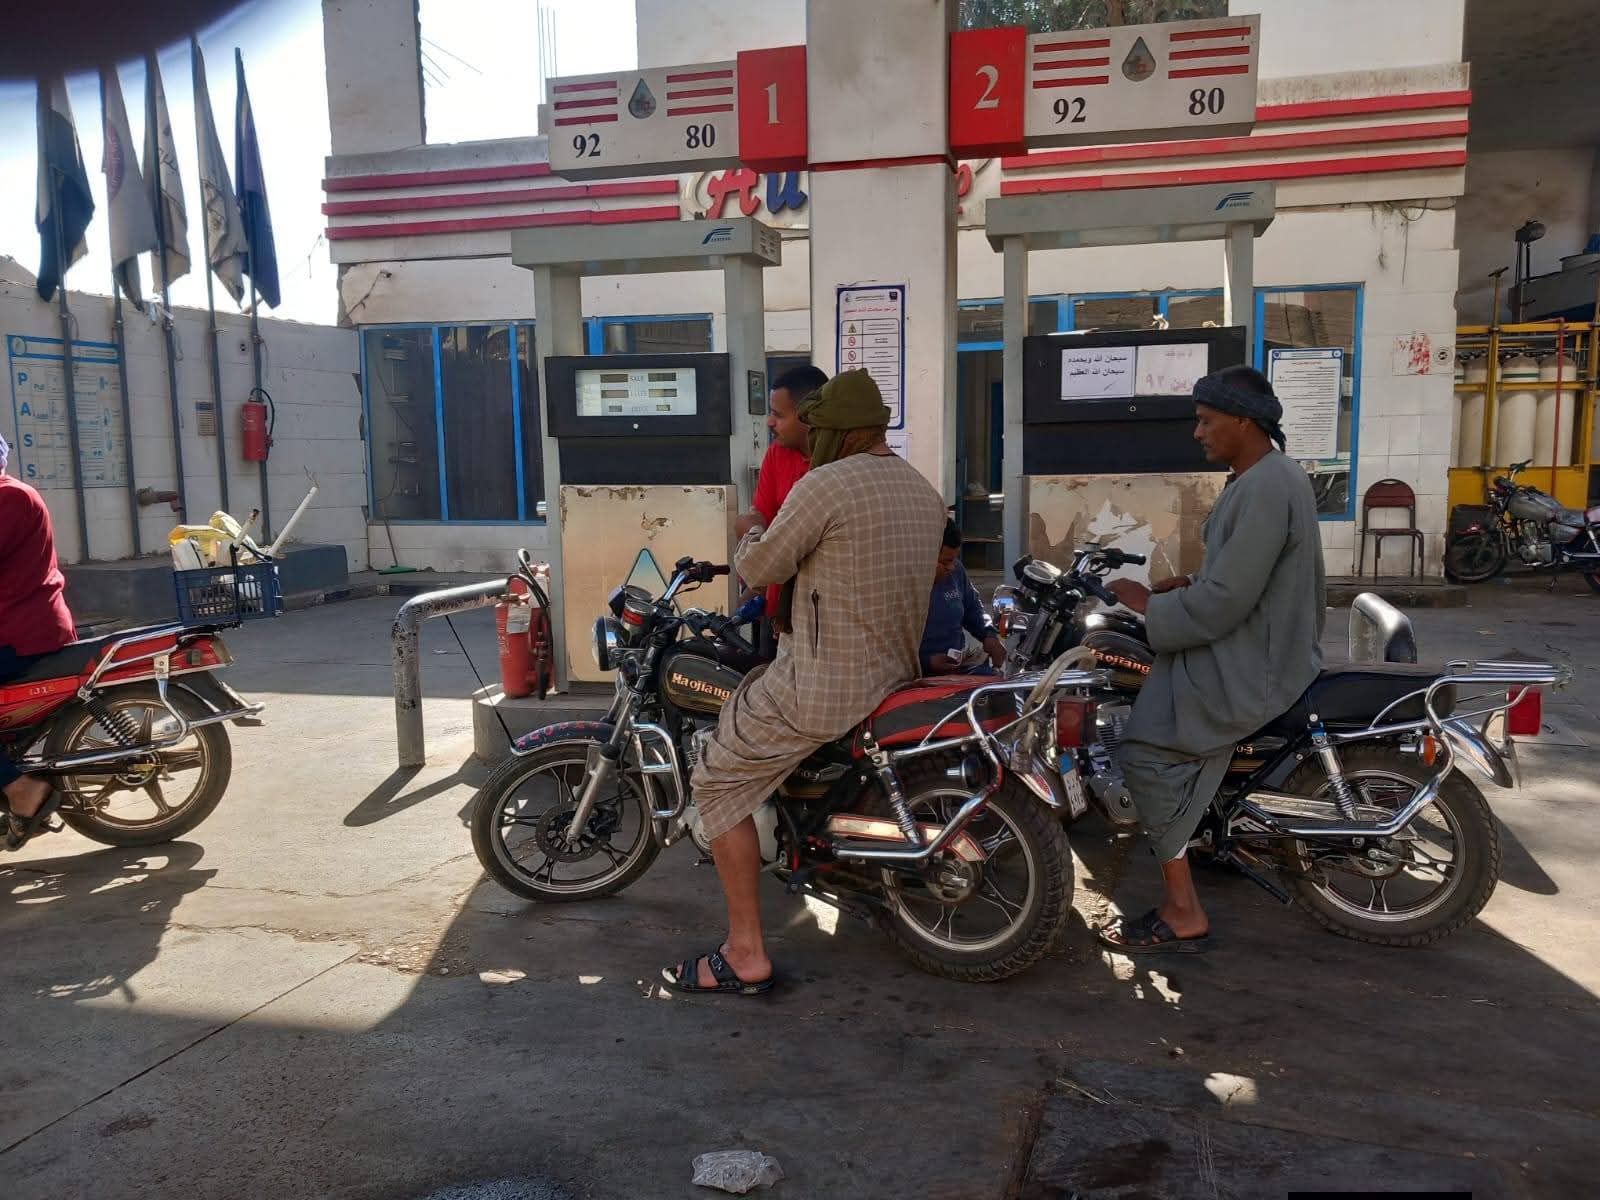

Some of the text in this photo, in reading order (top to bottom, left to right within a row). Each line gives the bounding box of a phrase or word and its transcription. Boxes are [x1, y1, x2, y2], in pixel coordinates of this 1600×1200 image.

[974, 65, 1000, 110] 2
[765, 82, 781, 125] 1
[1053, 97, 1087, 125] 92
[1188, 87, 1225, 116] 80
[573, 133, 601, 158] 92
[686, 123, 716, 149] 80
[1104, 354, 1127, 364] سبحان
[17, 372, 28, 386] P
[1102, 367, 1125, 377] سبحان
[20, 402, 31, 417] A
[23, 433, 33, 447] S
[26, 463, 36, 477] S
